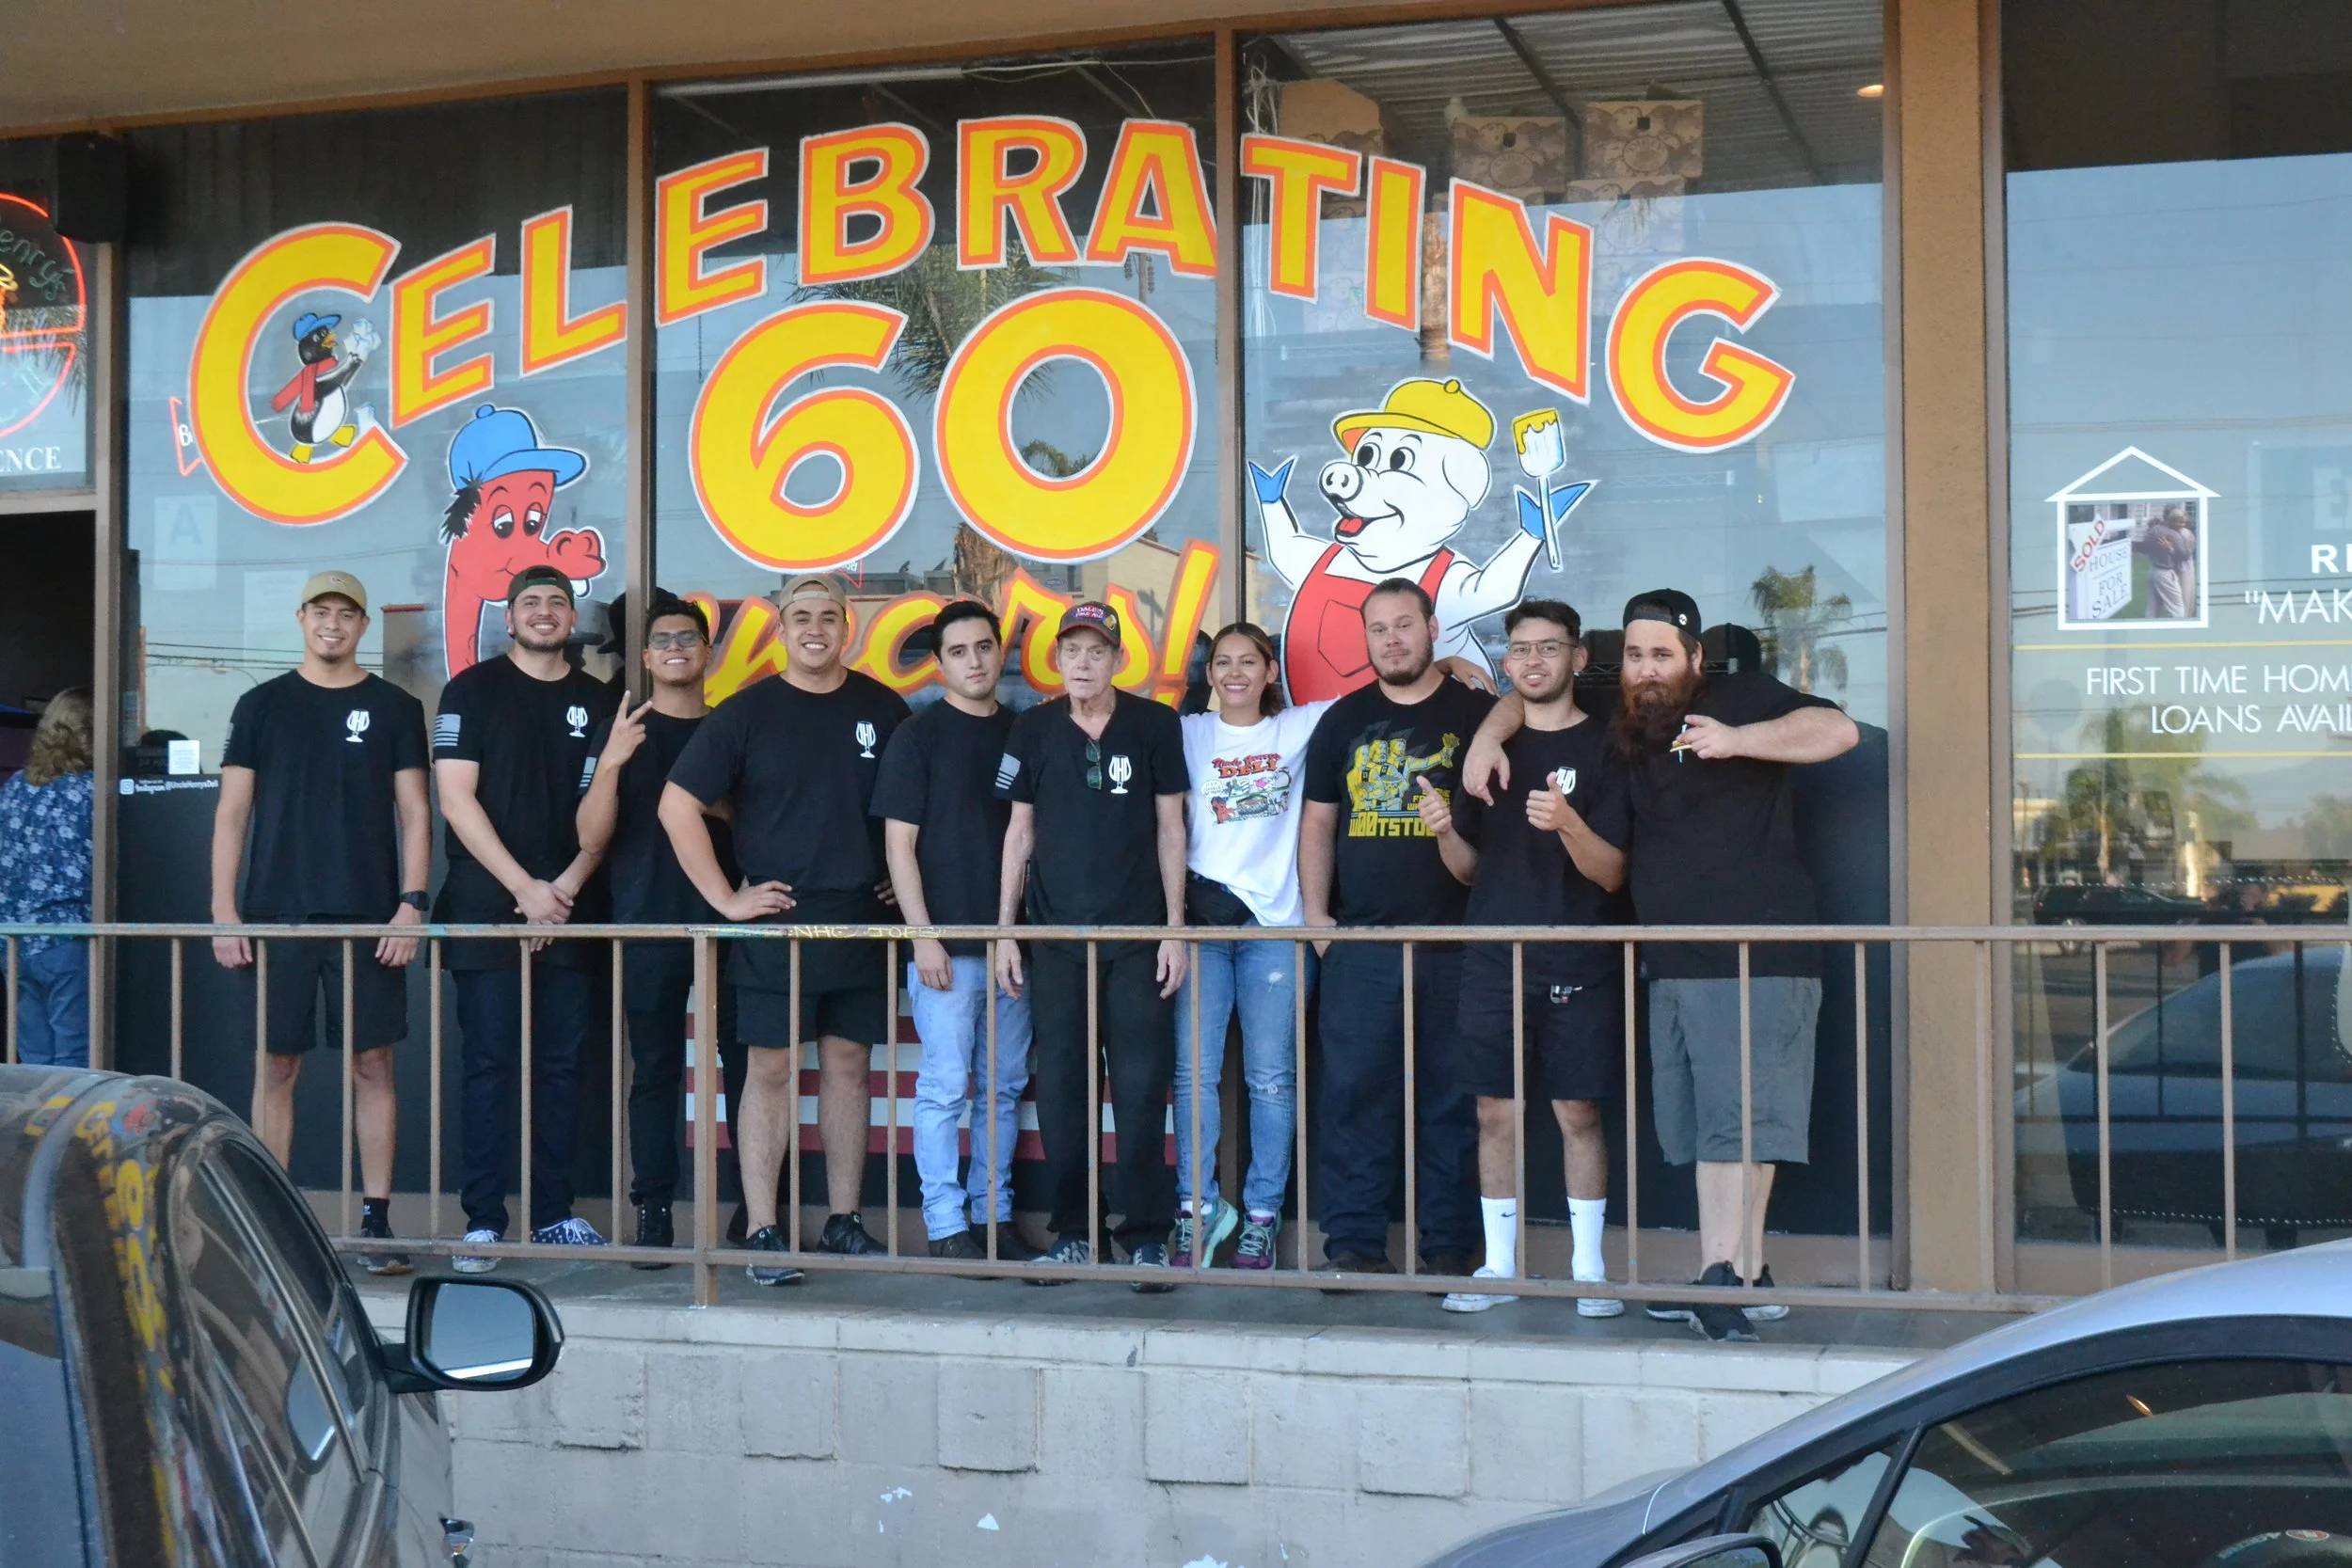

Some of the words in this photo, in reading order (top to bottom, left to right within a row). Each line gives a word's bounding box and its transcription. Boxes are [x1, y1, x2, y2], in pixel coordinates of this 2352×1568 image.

[190, 114, 1796, 527] CELEBRATING
[688, 287, 1198, 572] 60
[0, 446, 61, 471] NCE
[2074, 520, 2105, 572] SOLD
[2087, 666, 2161, 695] FIRST
[2174, 665, 2247, 693] TIME
[2265, 663, 2352, 693] HOM
[2152, 704, 2262, 734] LOANS
[1217, 758, 1278, 779] DELI
